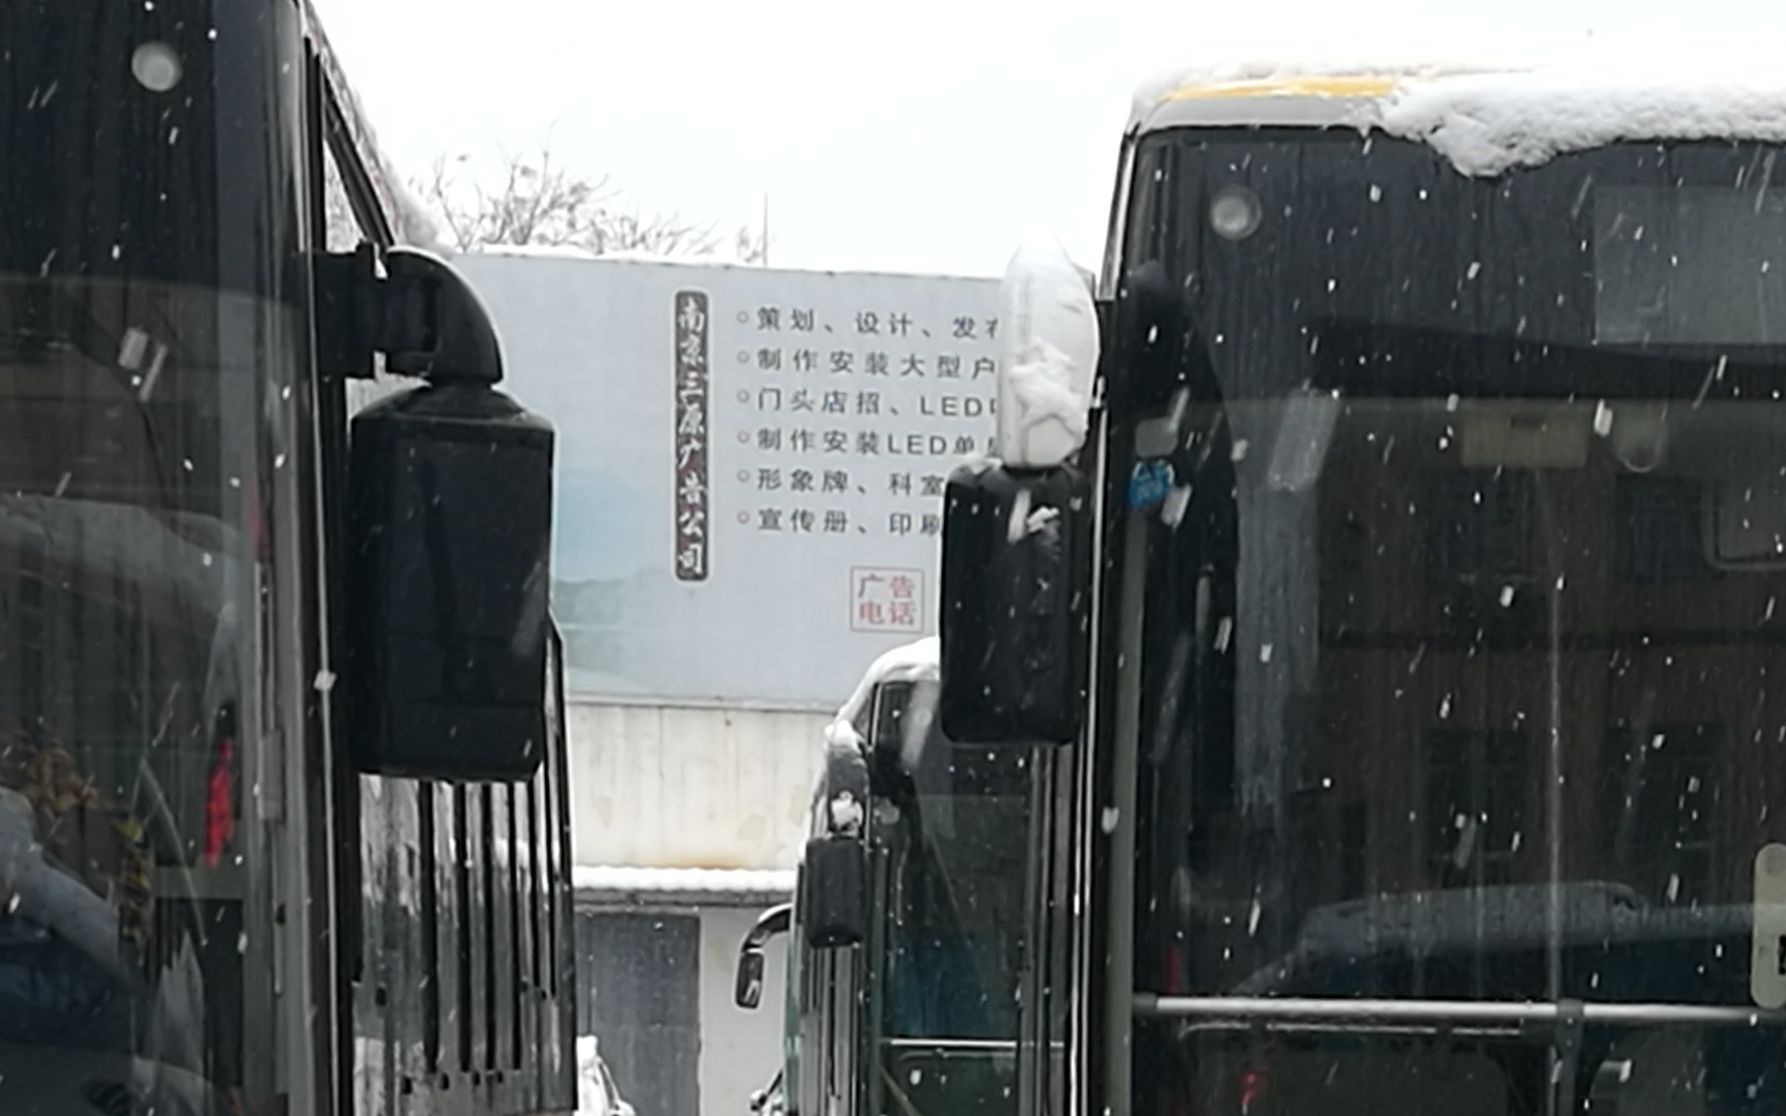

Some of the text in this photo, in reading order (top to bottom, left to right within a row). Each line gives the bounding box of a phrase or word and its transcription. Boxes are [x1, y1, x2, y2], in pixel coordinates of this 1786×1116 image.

[758, 387, 995, 417] 门头店招、LED
[757, 468, 944, 496] 形象牌、科室
[858, 574, 916, 600] 广告
[859, 600, 916, 626] 电话
